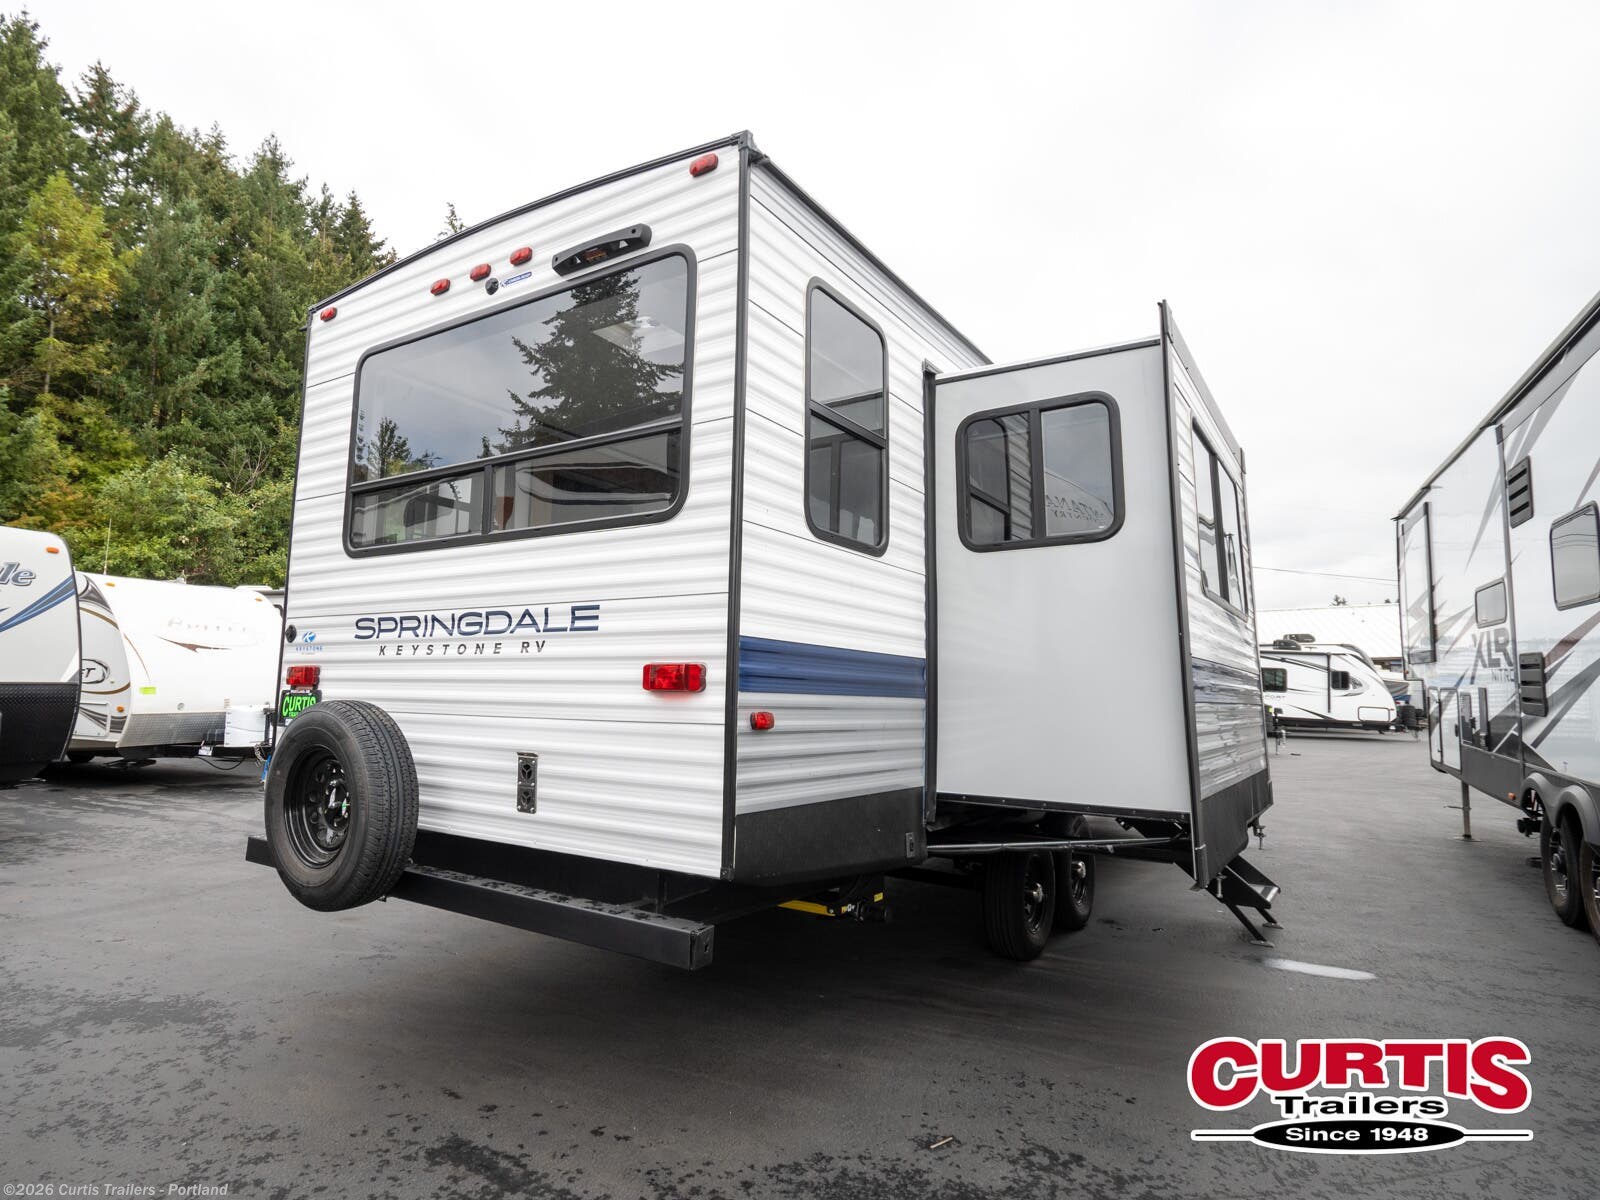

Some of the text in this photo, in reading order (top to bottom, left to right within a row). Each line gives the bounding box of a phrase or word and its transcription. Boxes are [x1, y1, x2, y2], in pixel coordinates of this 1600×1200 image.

[354, 604, 600, 639] SPRINGDALE
[379, 640, 546, 656] KEYSTONE RV
[1471, 628, 1513, 676] XLR
